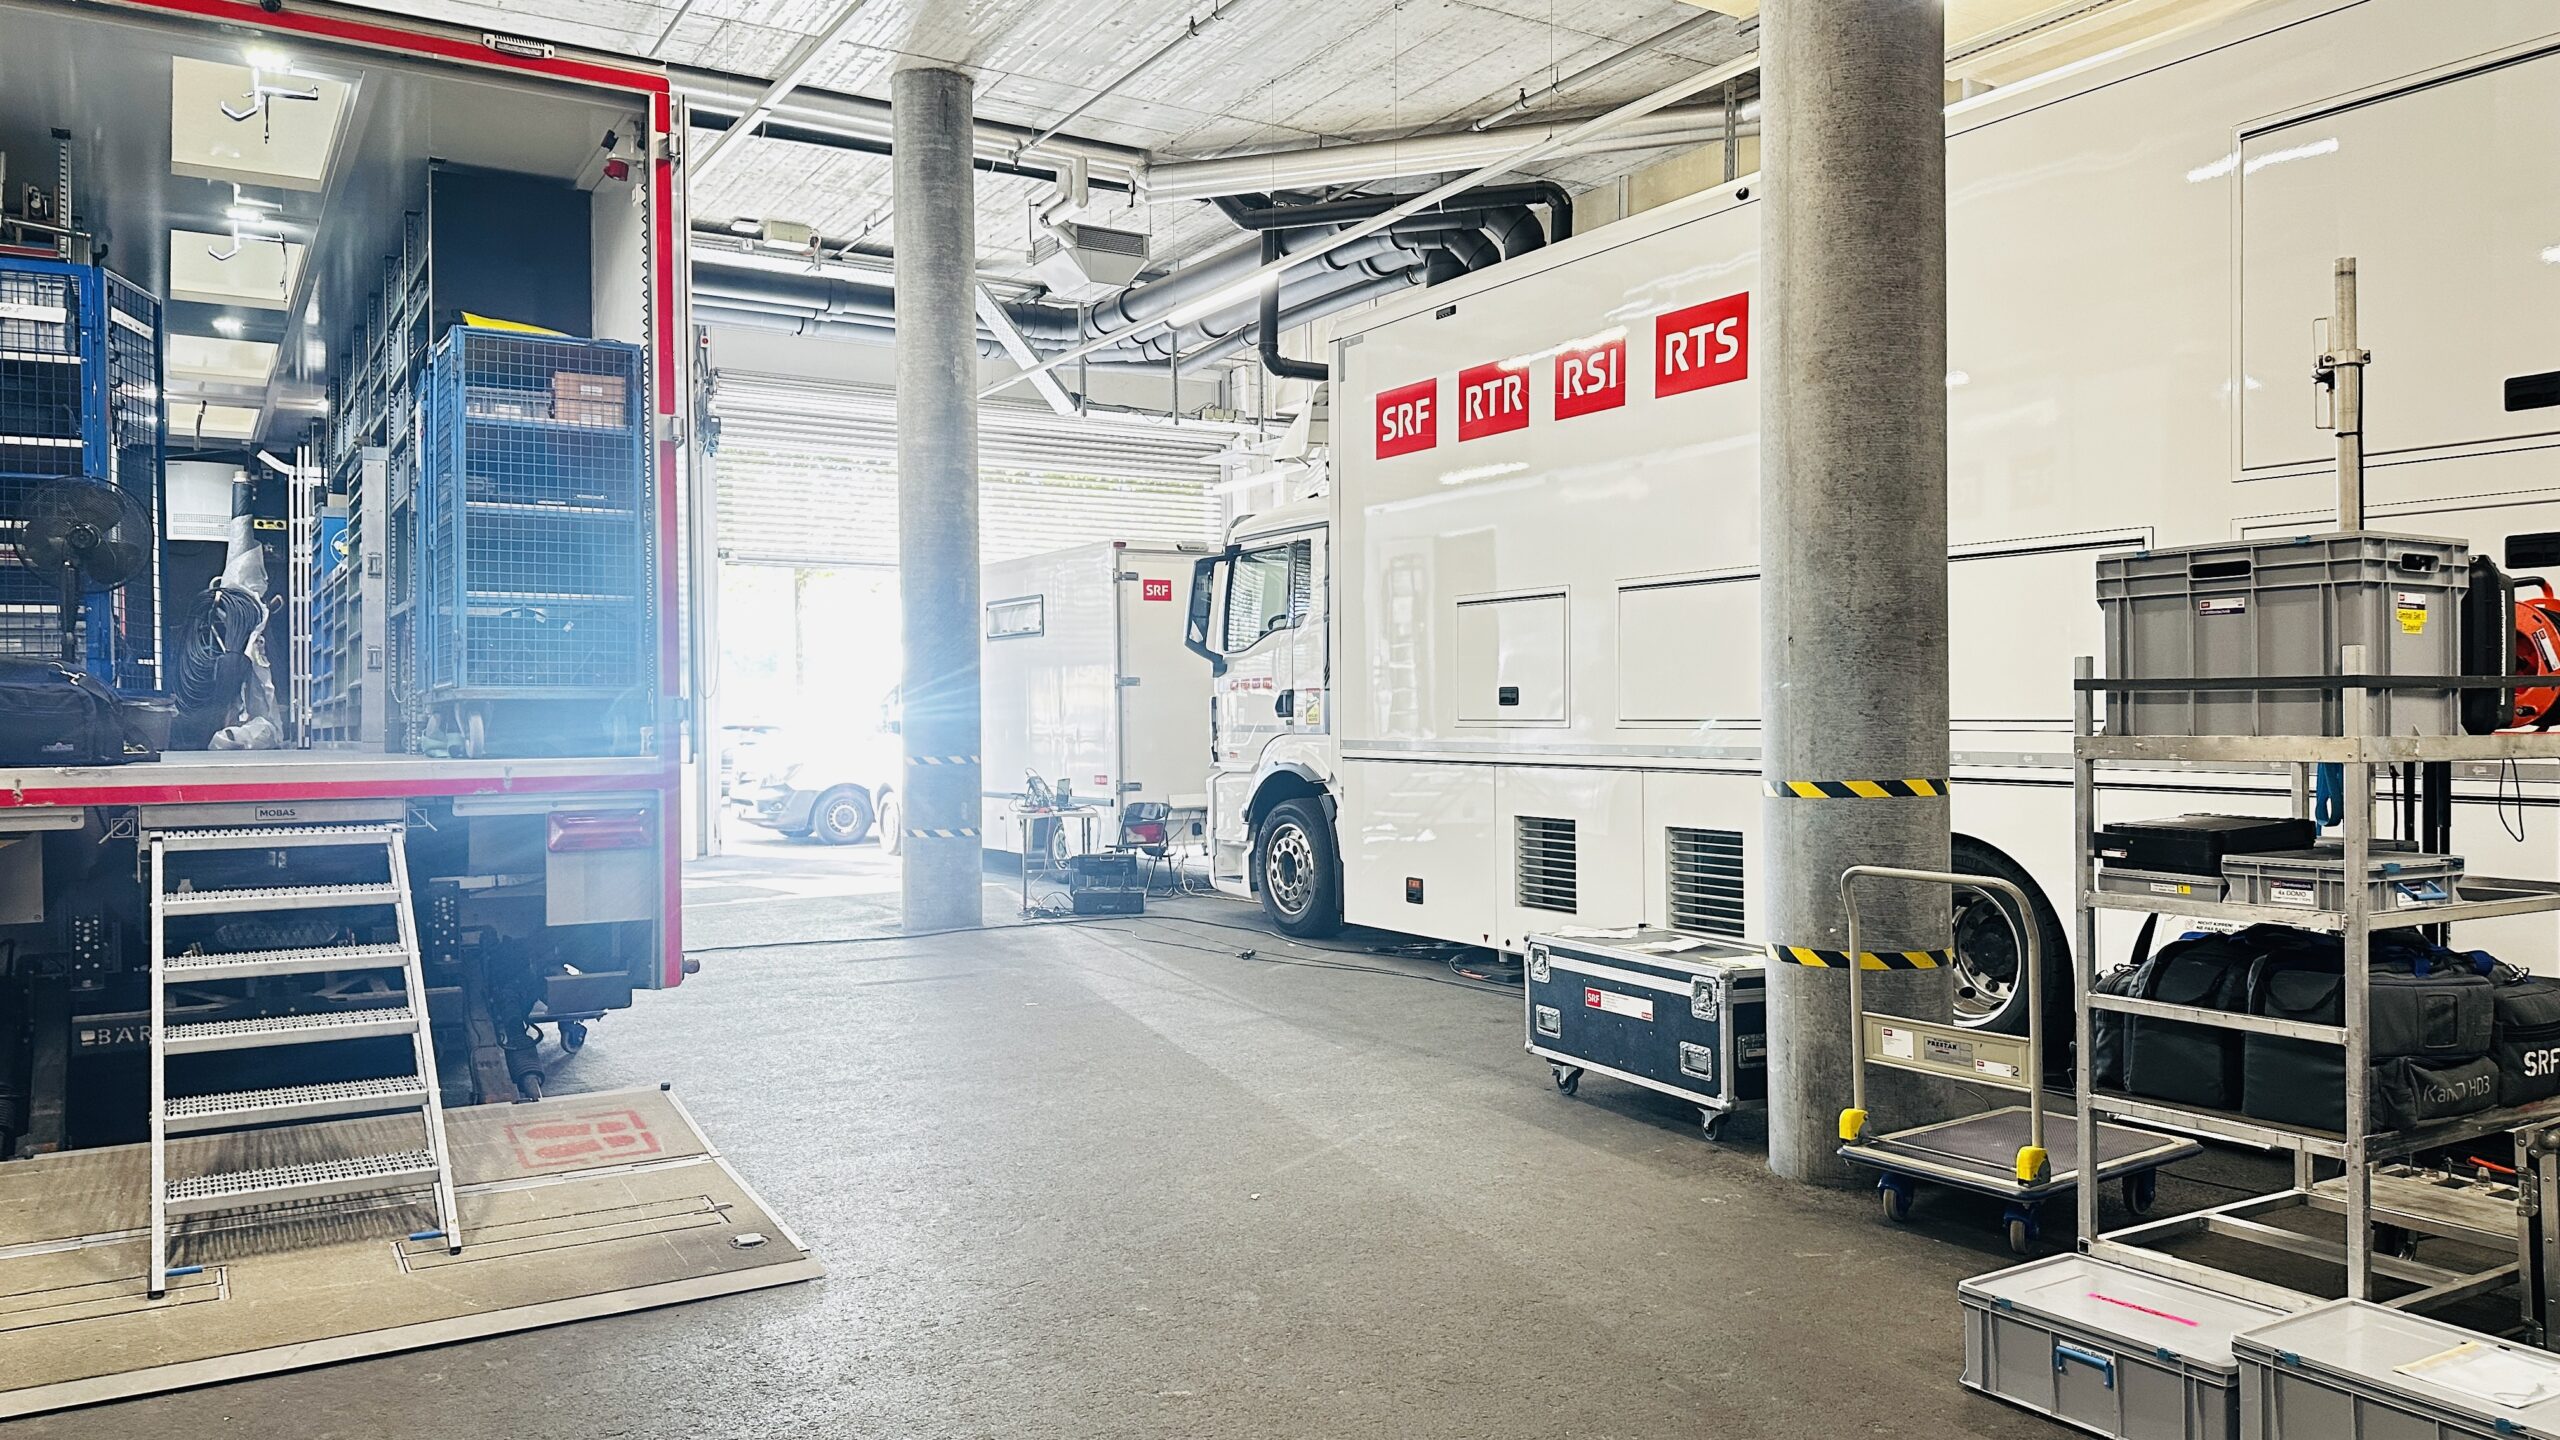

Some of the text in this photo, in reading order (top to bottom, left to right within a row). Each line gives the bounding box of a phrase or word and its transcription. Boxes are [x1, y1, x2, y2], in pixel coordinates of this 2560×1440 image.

[1381, 317, 1740, 442] SRF RTR RSI RTS
[1145, 584, 1169, 597] SRF
[259, 808, 296, 817] MOBAS
[2286, 890, 2307, 898] DOMO
[1587, 992, 1600, 1004] SRF
[2523, 1047, 2560, 1077] SRF
[2012, 1065, 2020, 1077] 2
[2468, 1075, 2490, 1097] HD3
